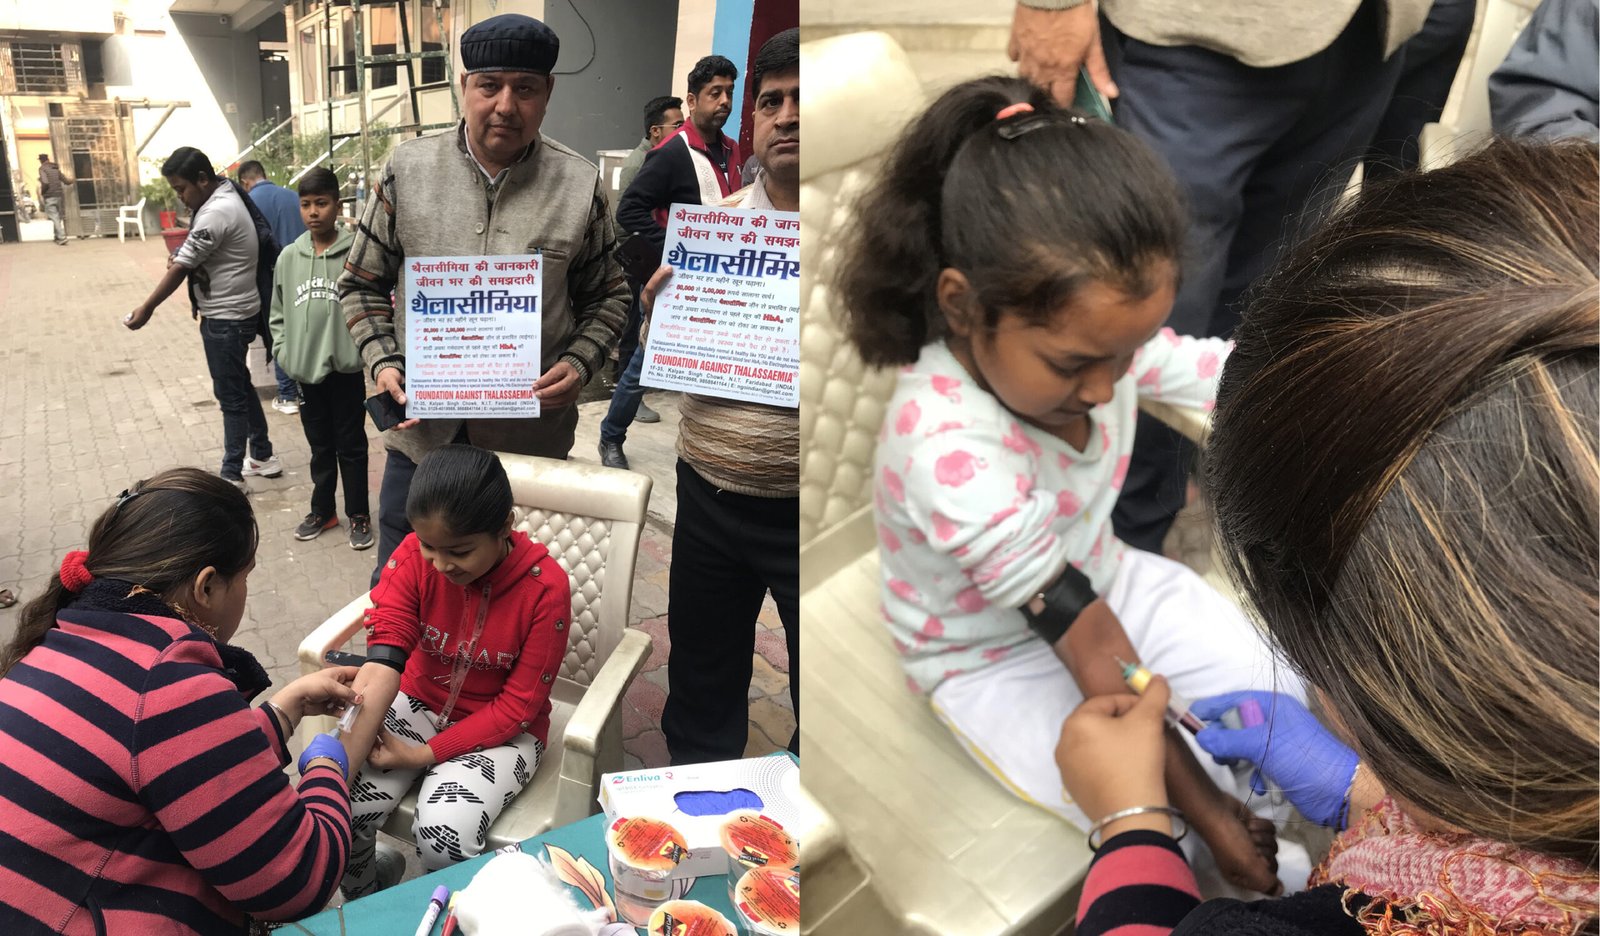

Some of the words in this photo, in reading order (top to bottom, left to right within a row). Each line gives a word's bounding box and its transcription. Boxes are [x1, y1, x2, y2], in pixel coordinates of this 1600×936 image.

[675, 208, 744, 226] थैलासीमिया
[751, 215, 768, 228] की
[678, 226, 710, 240] जीवन
[716, 232, 734, 242] भर
[741, 231, 757, 244] की
[412, 261, 469, 273] थैलासीमिया
[475, 260, 488, 272] की
[494, 259, 539, 271] जानकारी
[416, 276, 443, 287] जीवन
[449, 278, 463, 287] भर
[469, 275, 482, 286] की
[489, 274, 535, 285] समझदारी
[411, 290, 538, 315] थैलासीमिया
[653, 353, 699, 369] FOUNDATION
[699, 360, 733, 374] AGAINST
[734, 365, 793, 383] THALASSAEMIA
[745, 379, 772, 387] Faridabad
[775, 383, 795, 391] (INDIA)
[416, 390, 454, 400] FOUNDATION
[455, 390, 482, 399] AGAINST
[484, 390, 533, 399] THALASSAEMIA
